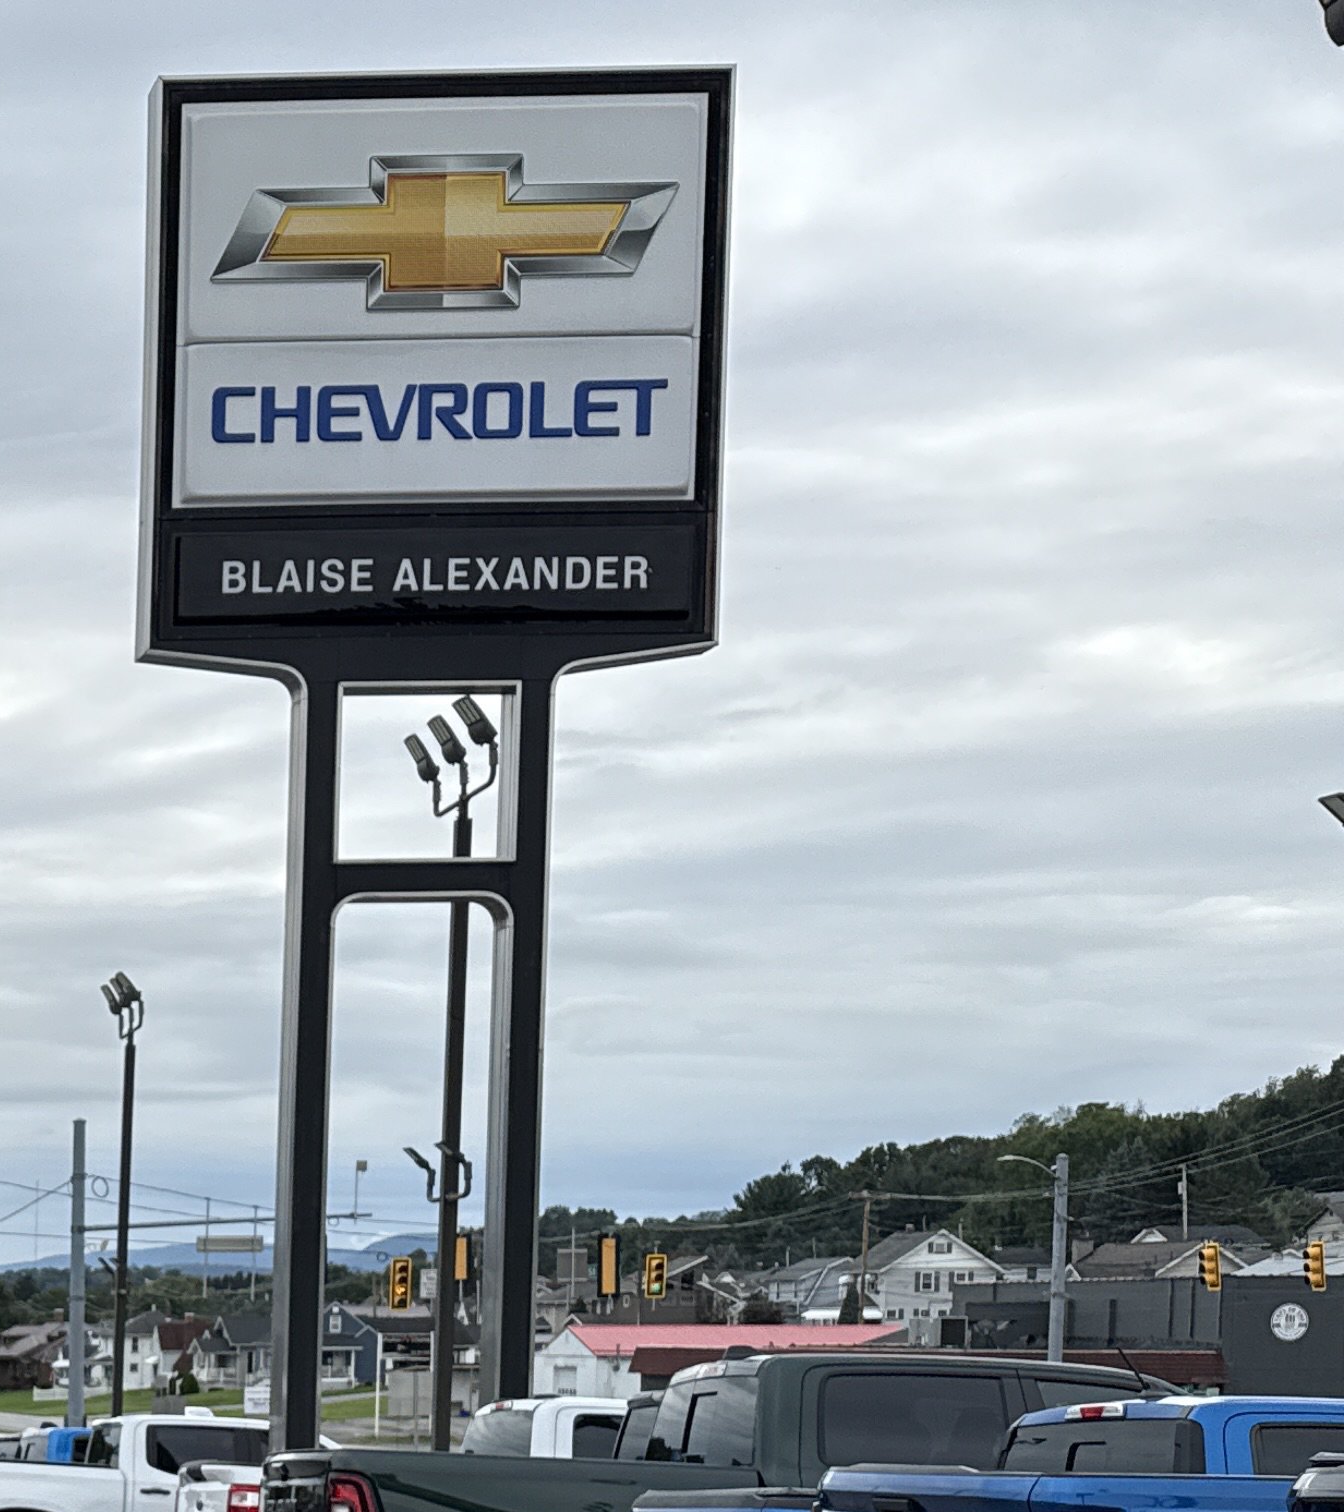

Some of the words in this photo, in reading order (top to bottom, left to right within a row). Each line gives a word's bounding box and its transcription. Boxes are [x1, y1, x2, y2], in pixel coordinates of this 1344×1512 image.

[212, 378, 668, 443] CHEVROLET
[222, 557, 374, 595] BLAISE
[393, 555, 649, 592] ALEXANDER
